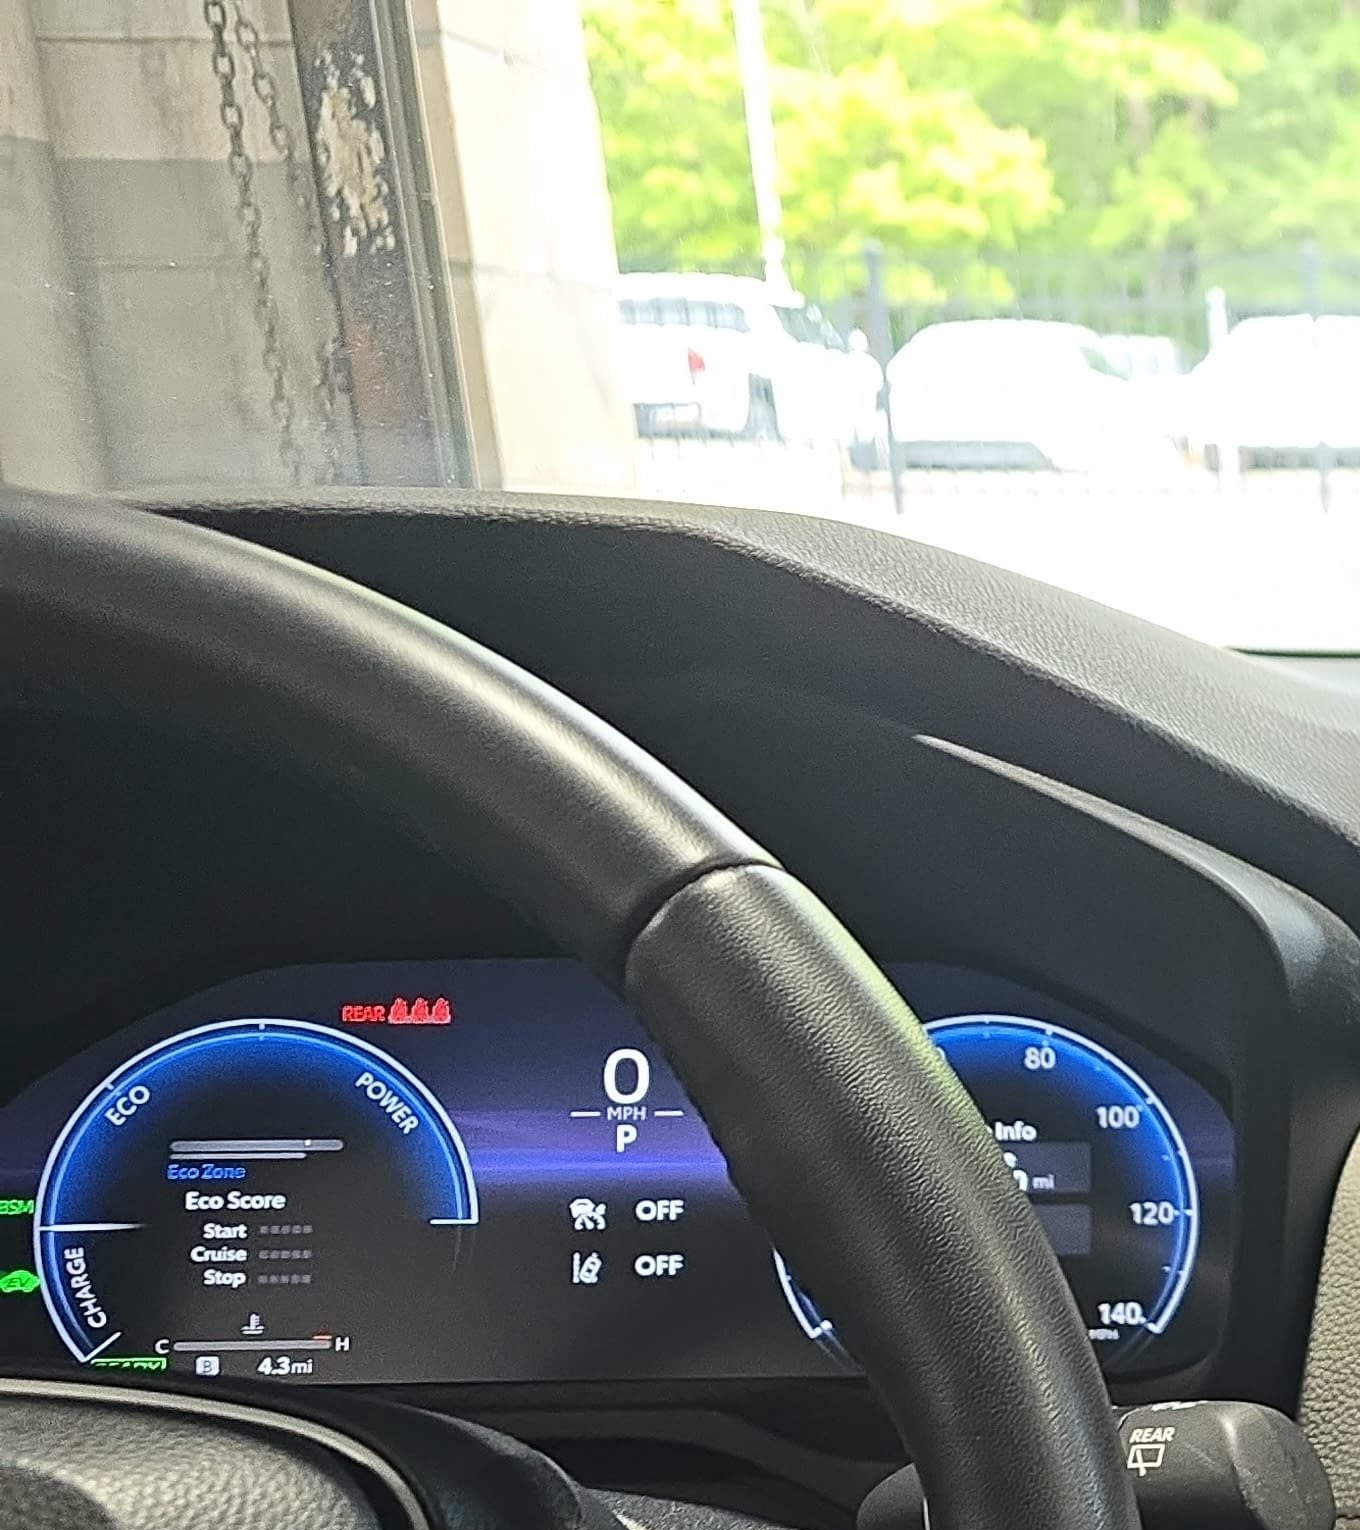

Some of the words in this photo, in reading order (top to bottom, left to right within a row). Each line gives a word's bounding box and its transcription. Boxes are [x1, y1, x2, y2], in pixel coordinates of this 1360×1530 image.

[342, 1005, 385, 1022] REAR
[1024, 1047, 1056, 1069] 80
[603, 1048, 650, 1104] 0
[105, 1085, 151, 1128] ECO
[354, 1072, 420, 1137] POWER
[607, 1107, 647, 1121] MPH
[1097, 1106, 1140, 1129] 100
[616, 1125, 638, 1153] P
[995, 1121, 1038, 1142] Info
[167, 1164, 199, 1180] Eco
[202, 1163, 247, 1180] Zone
[1032, 1174, 1056, 1191] mi
[185, 1191, 224, 1210] Eco
[227, 1191, 287, 1210] Score
[635, 1199, 684, 1222] OFF
[1130, 1202, 1175, 1225] 120
[202, 1223, 248, 1239] Start
[190, 1246, 248, 1262] Cruise
[635, 1255, 684, 1277] OFF
[63, 1247, 108, 1329] CHARGE
[203, 1269, 247, 1288] Stop
[155, 1339, 170, 1355] C
[335, 1336, 350, 1352] H
[1129, 1426, 1176, 1444] REAR
